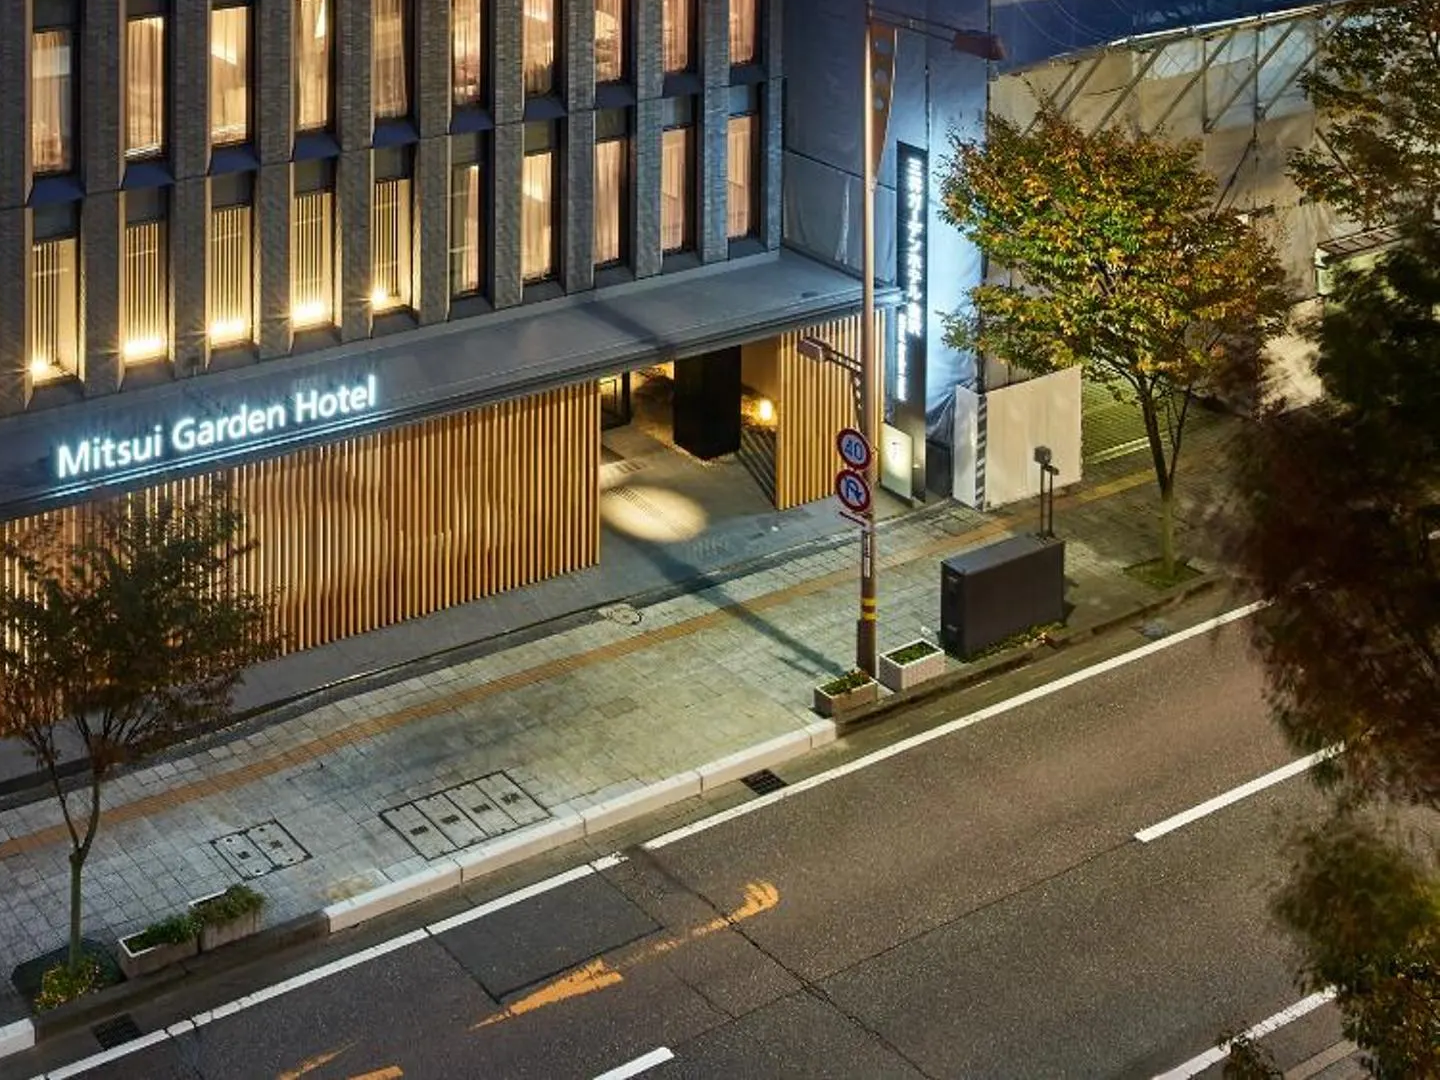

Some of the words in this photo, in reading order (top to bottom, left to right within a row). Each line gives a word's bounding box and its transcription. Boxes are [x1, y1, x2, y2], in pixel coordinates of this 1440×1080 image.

[57, 426, 162, 478] Mitsui
[172, 403, 285, 451] Garden
[295, 374, 376, 422] Hotel
[844, 439, 865, 461] 40
